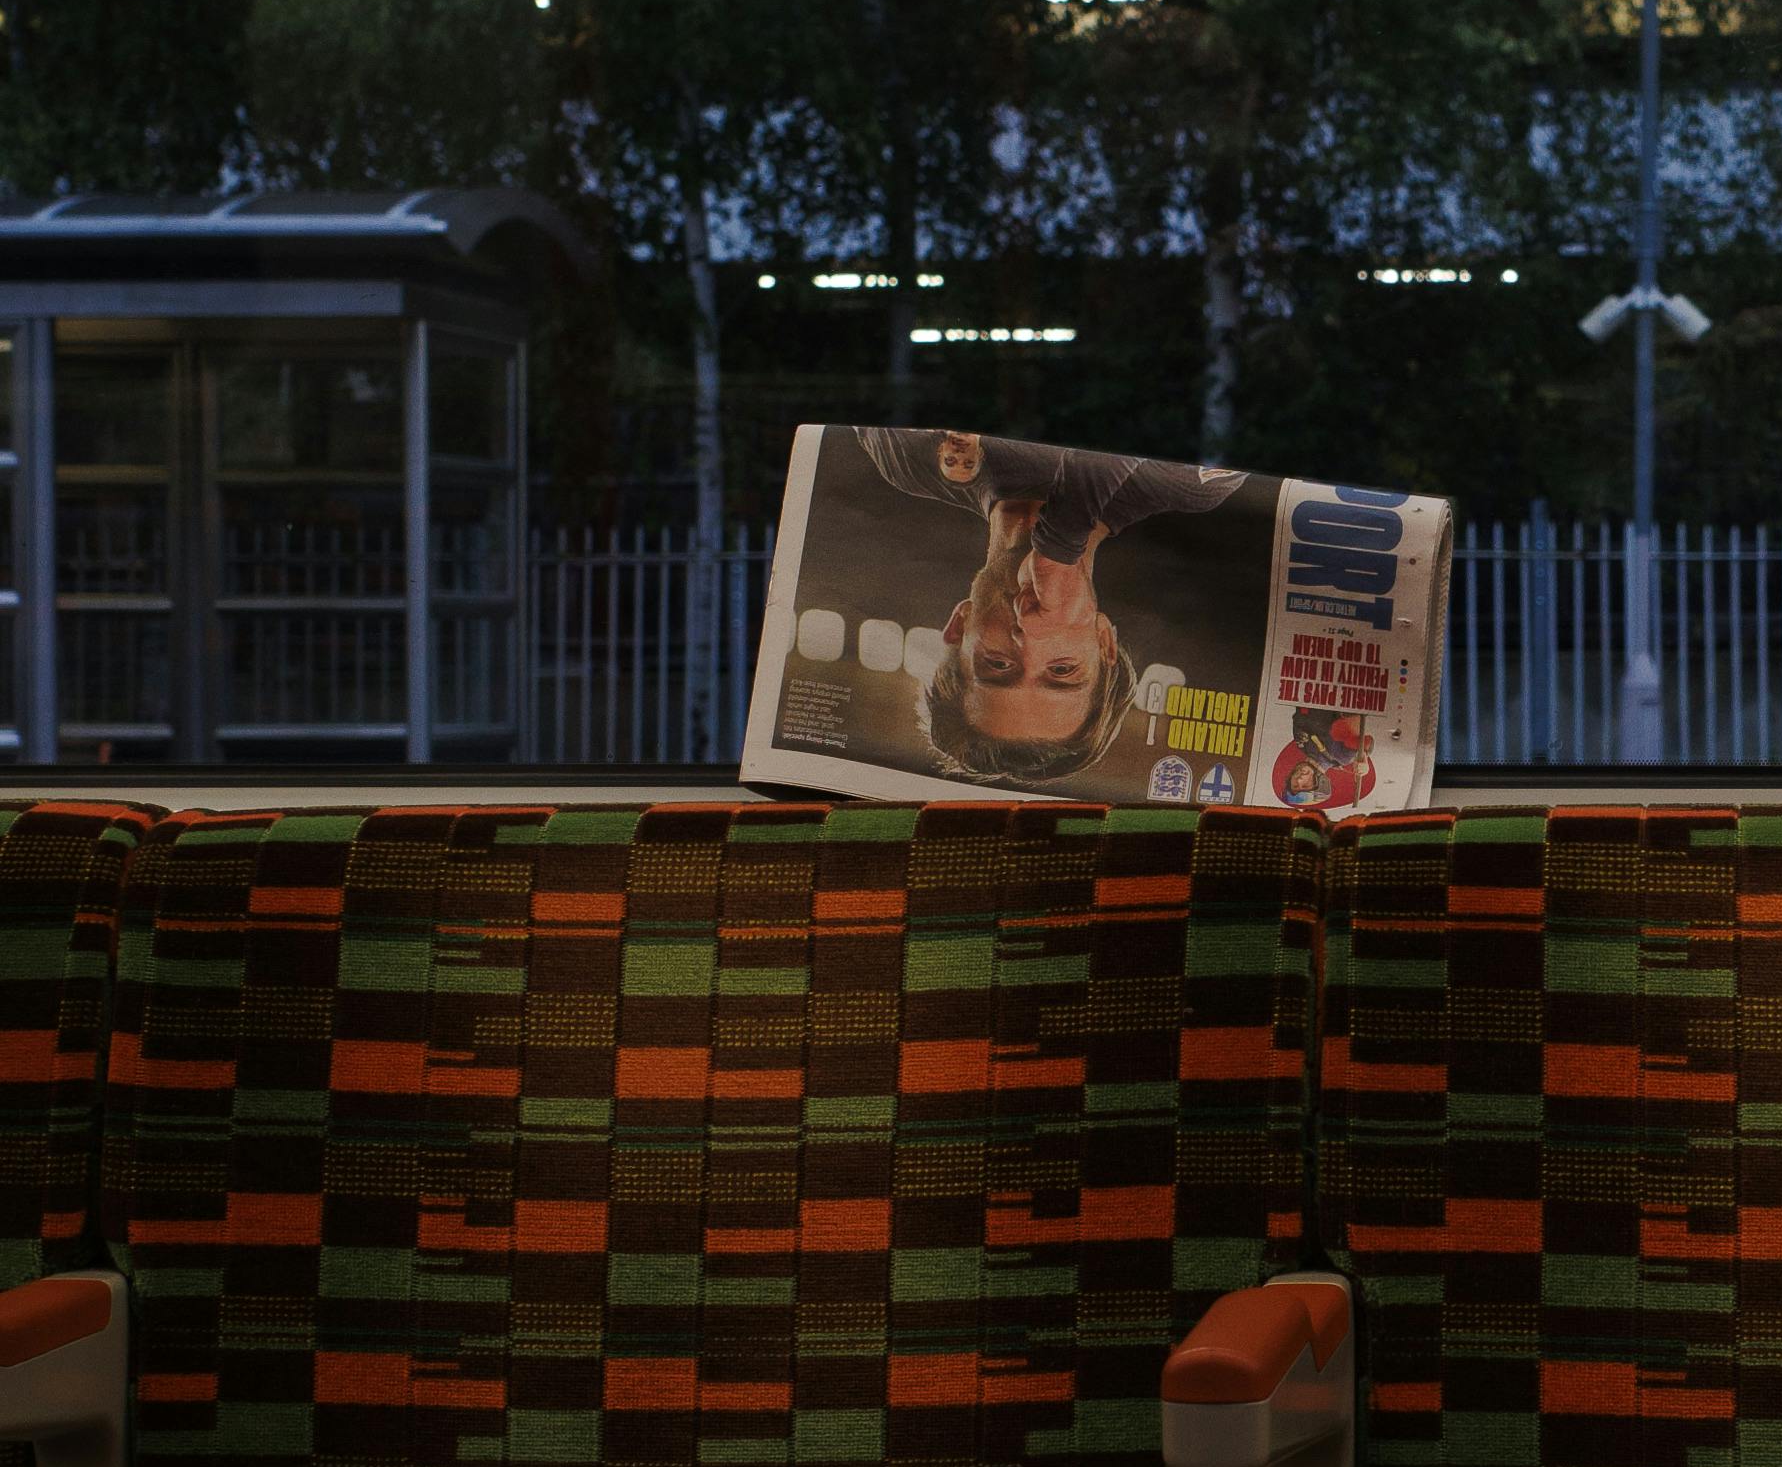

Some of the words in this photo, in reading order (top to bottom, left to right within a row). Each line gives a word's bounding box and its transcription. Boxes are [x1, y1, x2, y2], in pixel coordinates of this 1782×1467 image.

[1292, 634, 1334, 659] DREAM
[1365, 643, 1382, 665] TO
[1279, 655, 1318, 681] BLOW
[1320, 661, 1335, 683] IN
[1337, 662, 1389, 689] PENALTY
[1146, 682, 1162, 714] 3
[1277, 679, 1300, 702] THE
[1302, 682, 1338, 707] PAYS
[1339, 686, 1387, 712] AINSLIE
[1165, 685, 1251, 726] ENGLAND
[1146, 715, 1157, 746] 1
[1167, 718, 1247, 758] FINLAND
